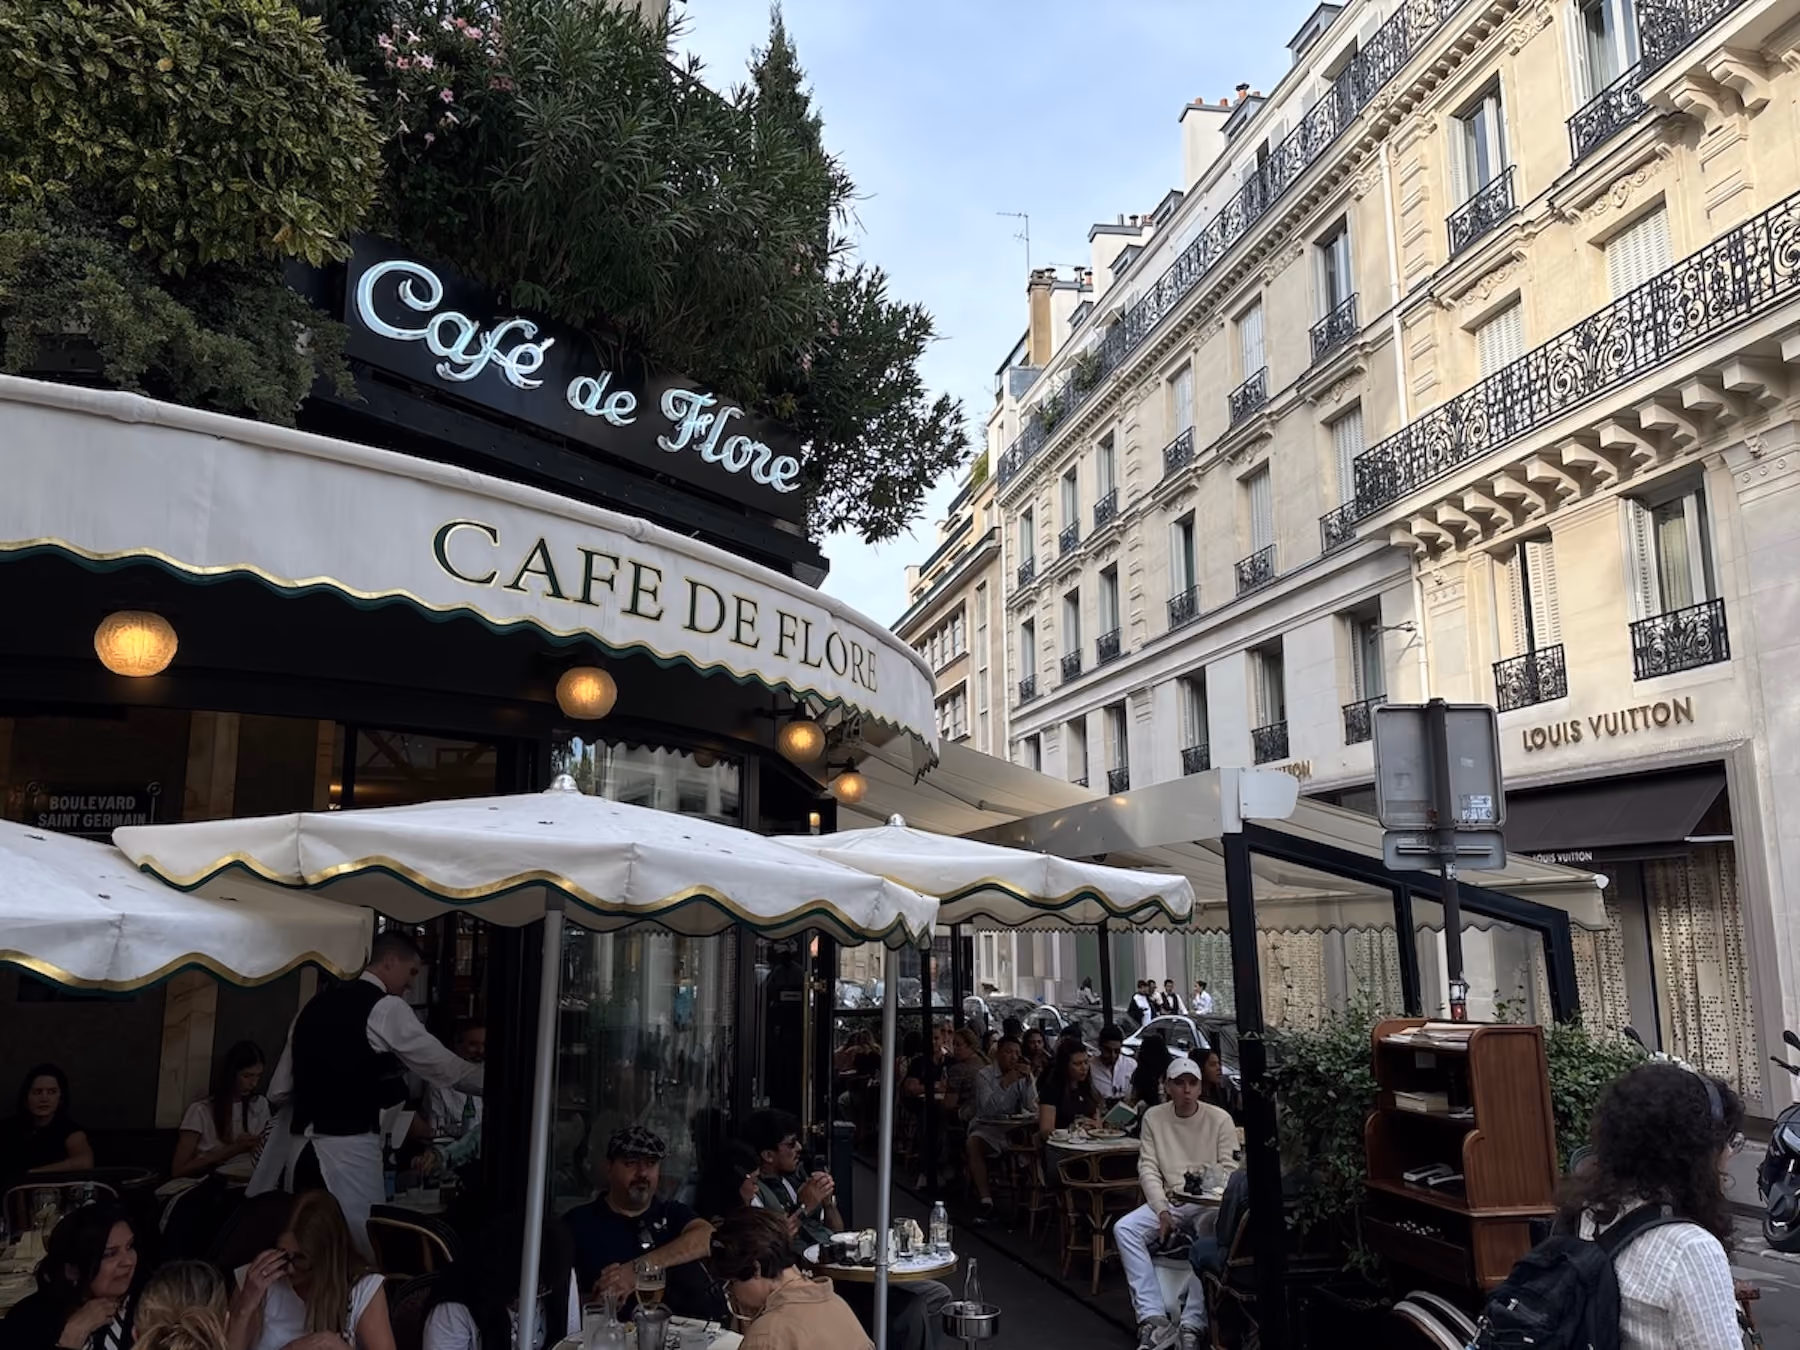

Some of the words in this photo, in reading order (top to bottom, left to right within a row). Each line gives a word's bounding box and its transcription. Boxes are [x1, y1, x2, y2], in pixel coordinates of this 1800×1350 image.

[356, 260, 554, 389] Café
[567, 371, 637, 426] de
[657, 388, 800, 493] Flore
[432, 518, 665, 621] CAFE
[683, 576, 761, 649] DE
[773, 609, 878, 693] FLORE
[1522, 720, 1583, 752] LOUIS
[1588, 696, 1694, 740] VUITTON
[38, 813, 80, 827] SAINT
[83, 813, 147, 827] GERMAIN
[50, 796, 136, 810] BOULEVARD
[1556, 851, 1593, 863] VUITTON
